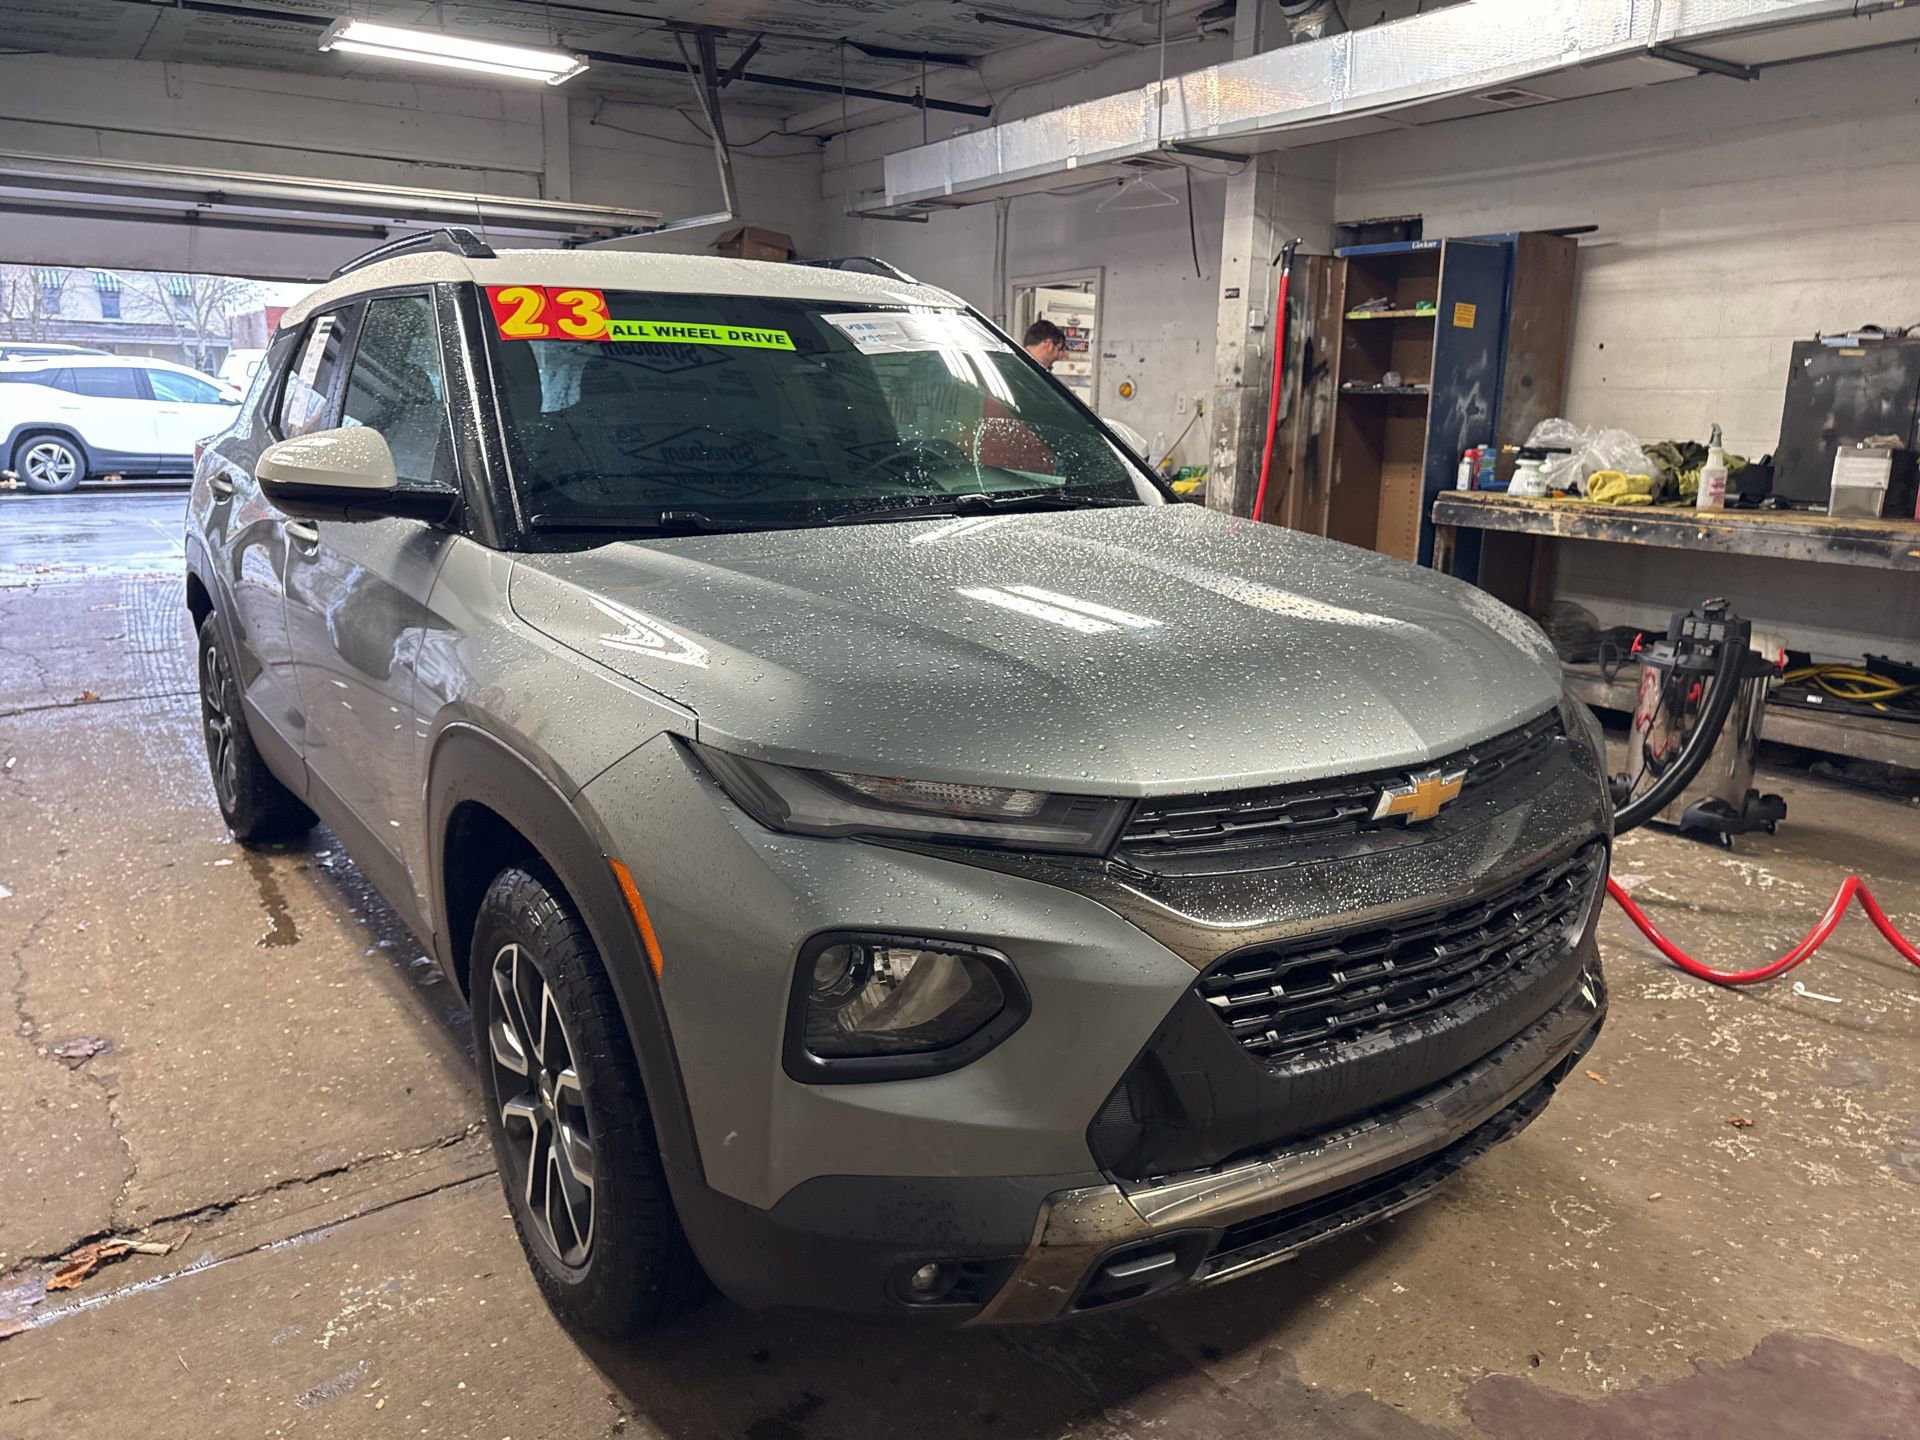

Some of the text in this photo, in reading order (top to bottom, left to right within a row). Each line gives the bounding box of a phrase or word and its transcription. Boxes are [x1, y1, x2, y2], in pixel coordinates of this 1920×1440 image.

[497, 287, 607, 339] 23
[612, 325, 787, 344] ALL WHEEL DRIVE
